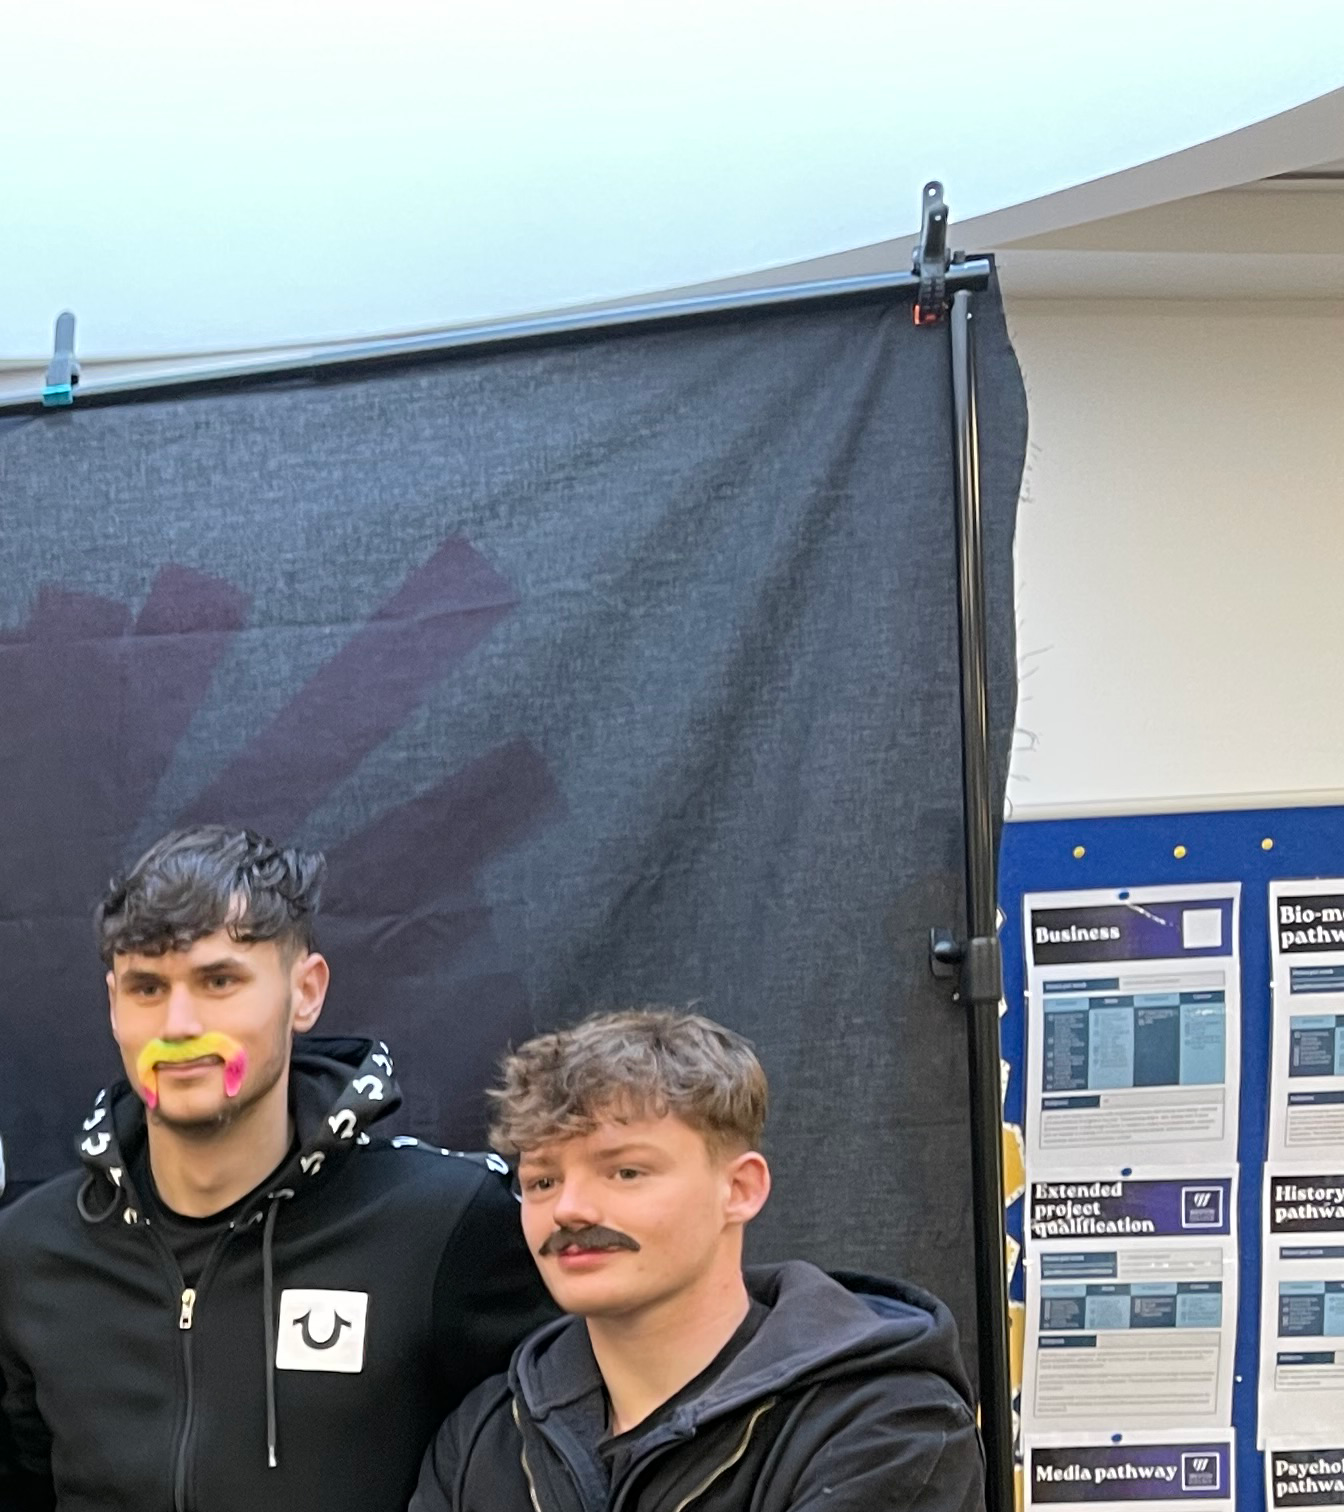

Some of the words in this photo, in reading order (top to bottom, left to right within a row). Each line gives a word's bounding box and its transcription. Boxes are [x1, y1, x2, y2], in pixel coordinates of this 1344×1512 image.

[1280, 905, 1344, 924] Bio-m
[1035, 923, 1120, 945] Business
[1034, 1181, 1123, 1199] Extended
[1275, 1185, 1344, 1204] History
[1034, 1201, 1101, 1222] project
[1033, 1217, 1155, 1238] qualification
[1036, 1464, 1092, 1482] Media
[1095, 1462, 1178, 1484] pathway
